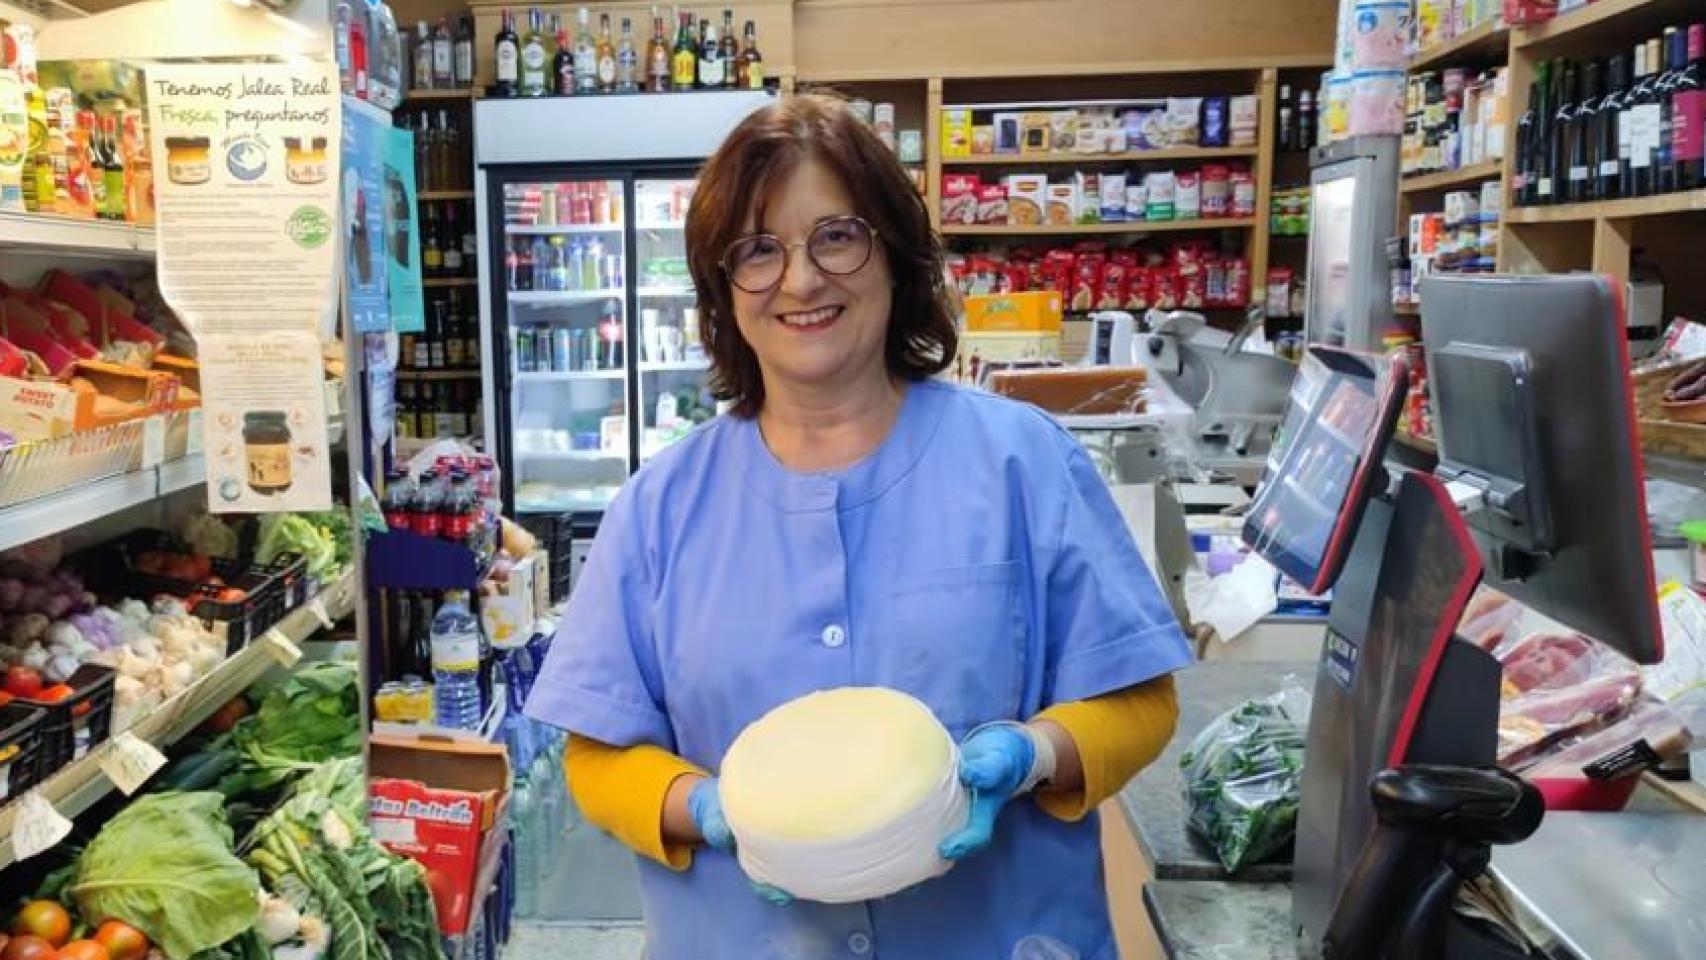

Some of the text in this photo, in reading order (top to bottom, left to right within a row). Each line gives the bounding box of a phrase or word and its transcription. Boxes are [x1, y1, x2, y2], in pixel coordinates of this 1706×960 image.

[153, 72, 331, 99] Tenemos Jalea Real
[157, 104, 218, 126] Fresca,
